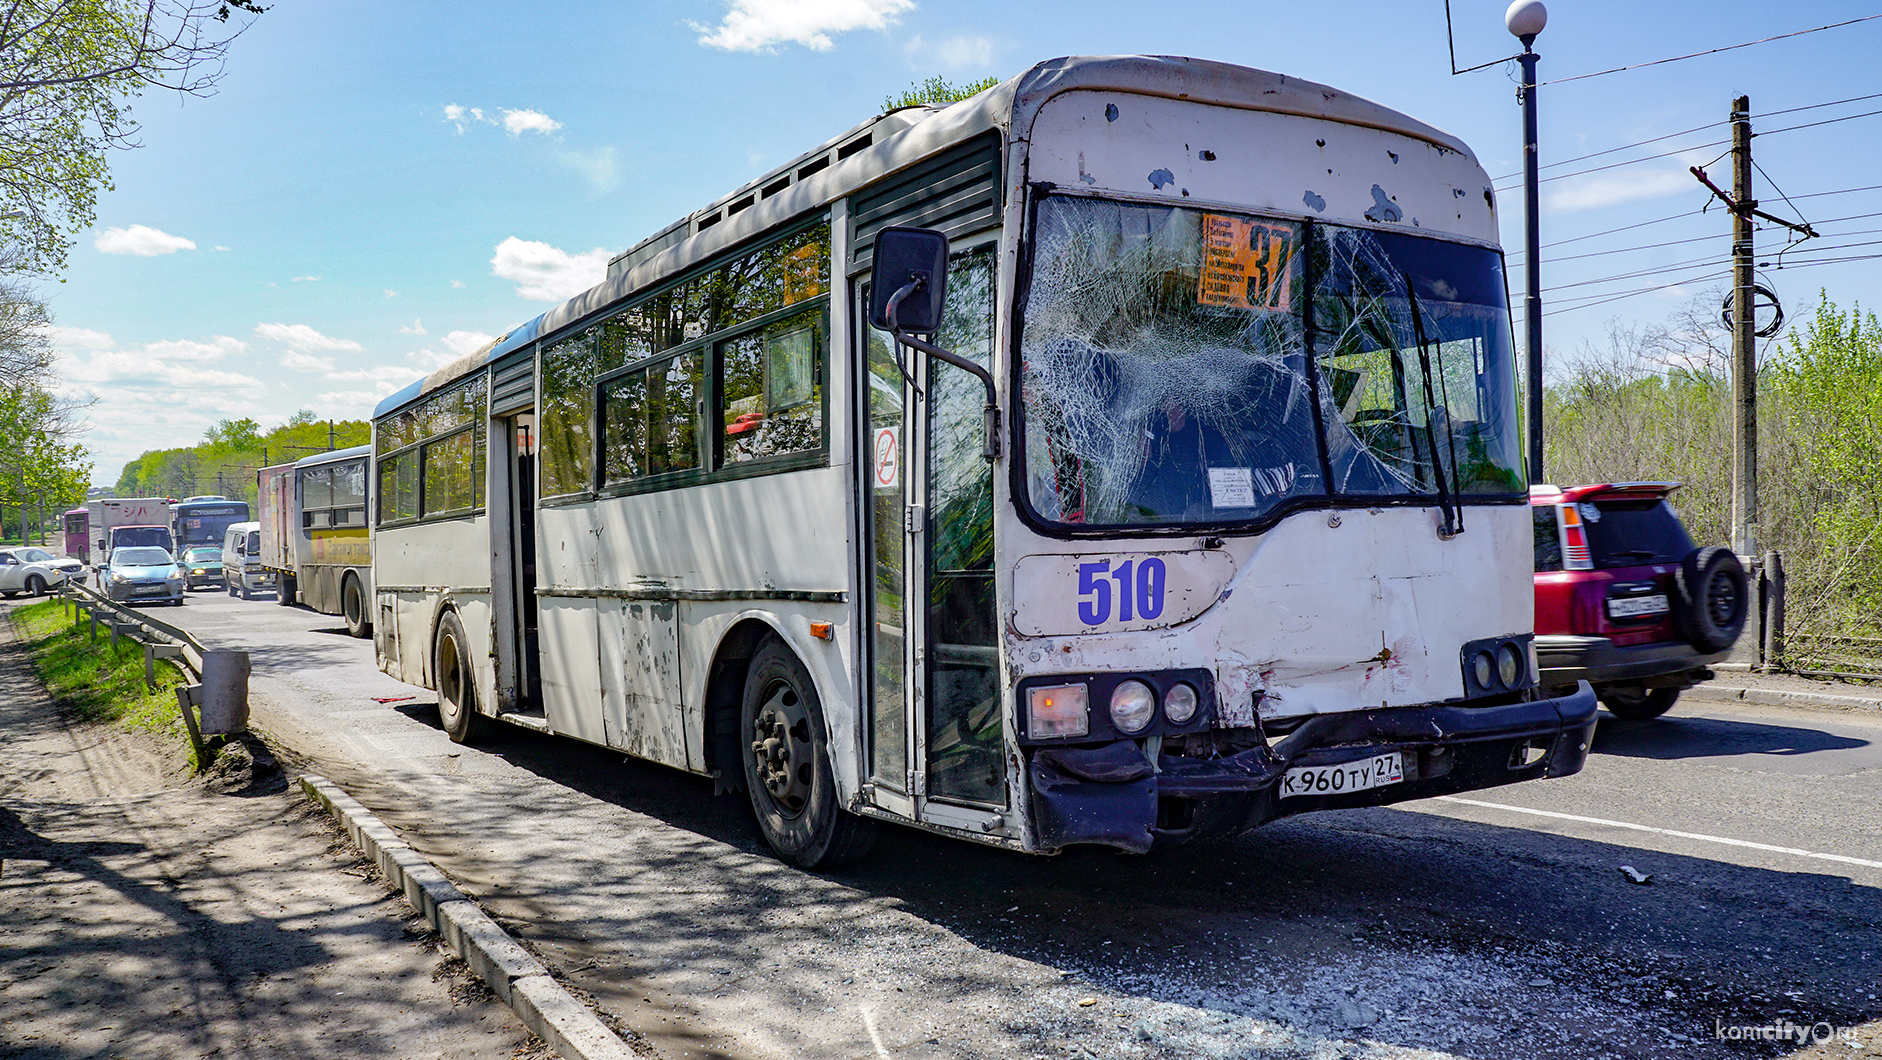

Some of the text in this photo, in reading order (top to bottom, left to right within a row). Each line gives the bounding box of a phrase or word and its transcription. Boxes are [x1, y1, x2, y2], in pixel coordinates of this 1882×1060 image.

[1247, 225, 1292, 308] 37
[1077, 557, 1166, 626] 510
[1375, 756, 1394, 777] 27
[1376, 774, 1391, 784] RUS
